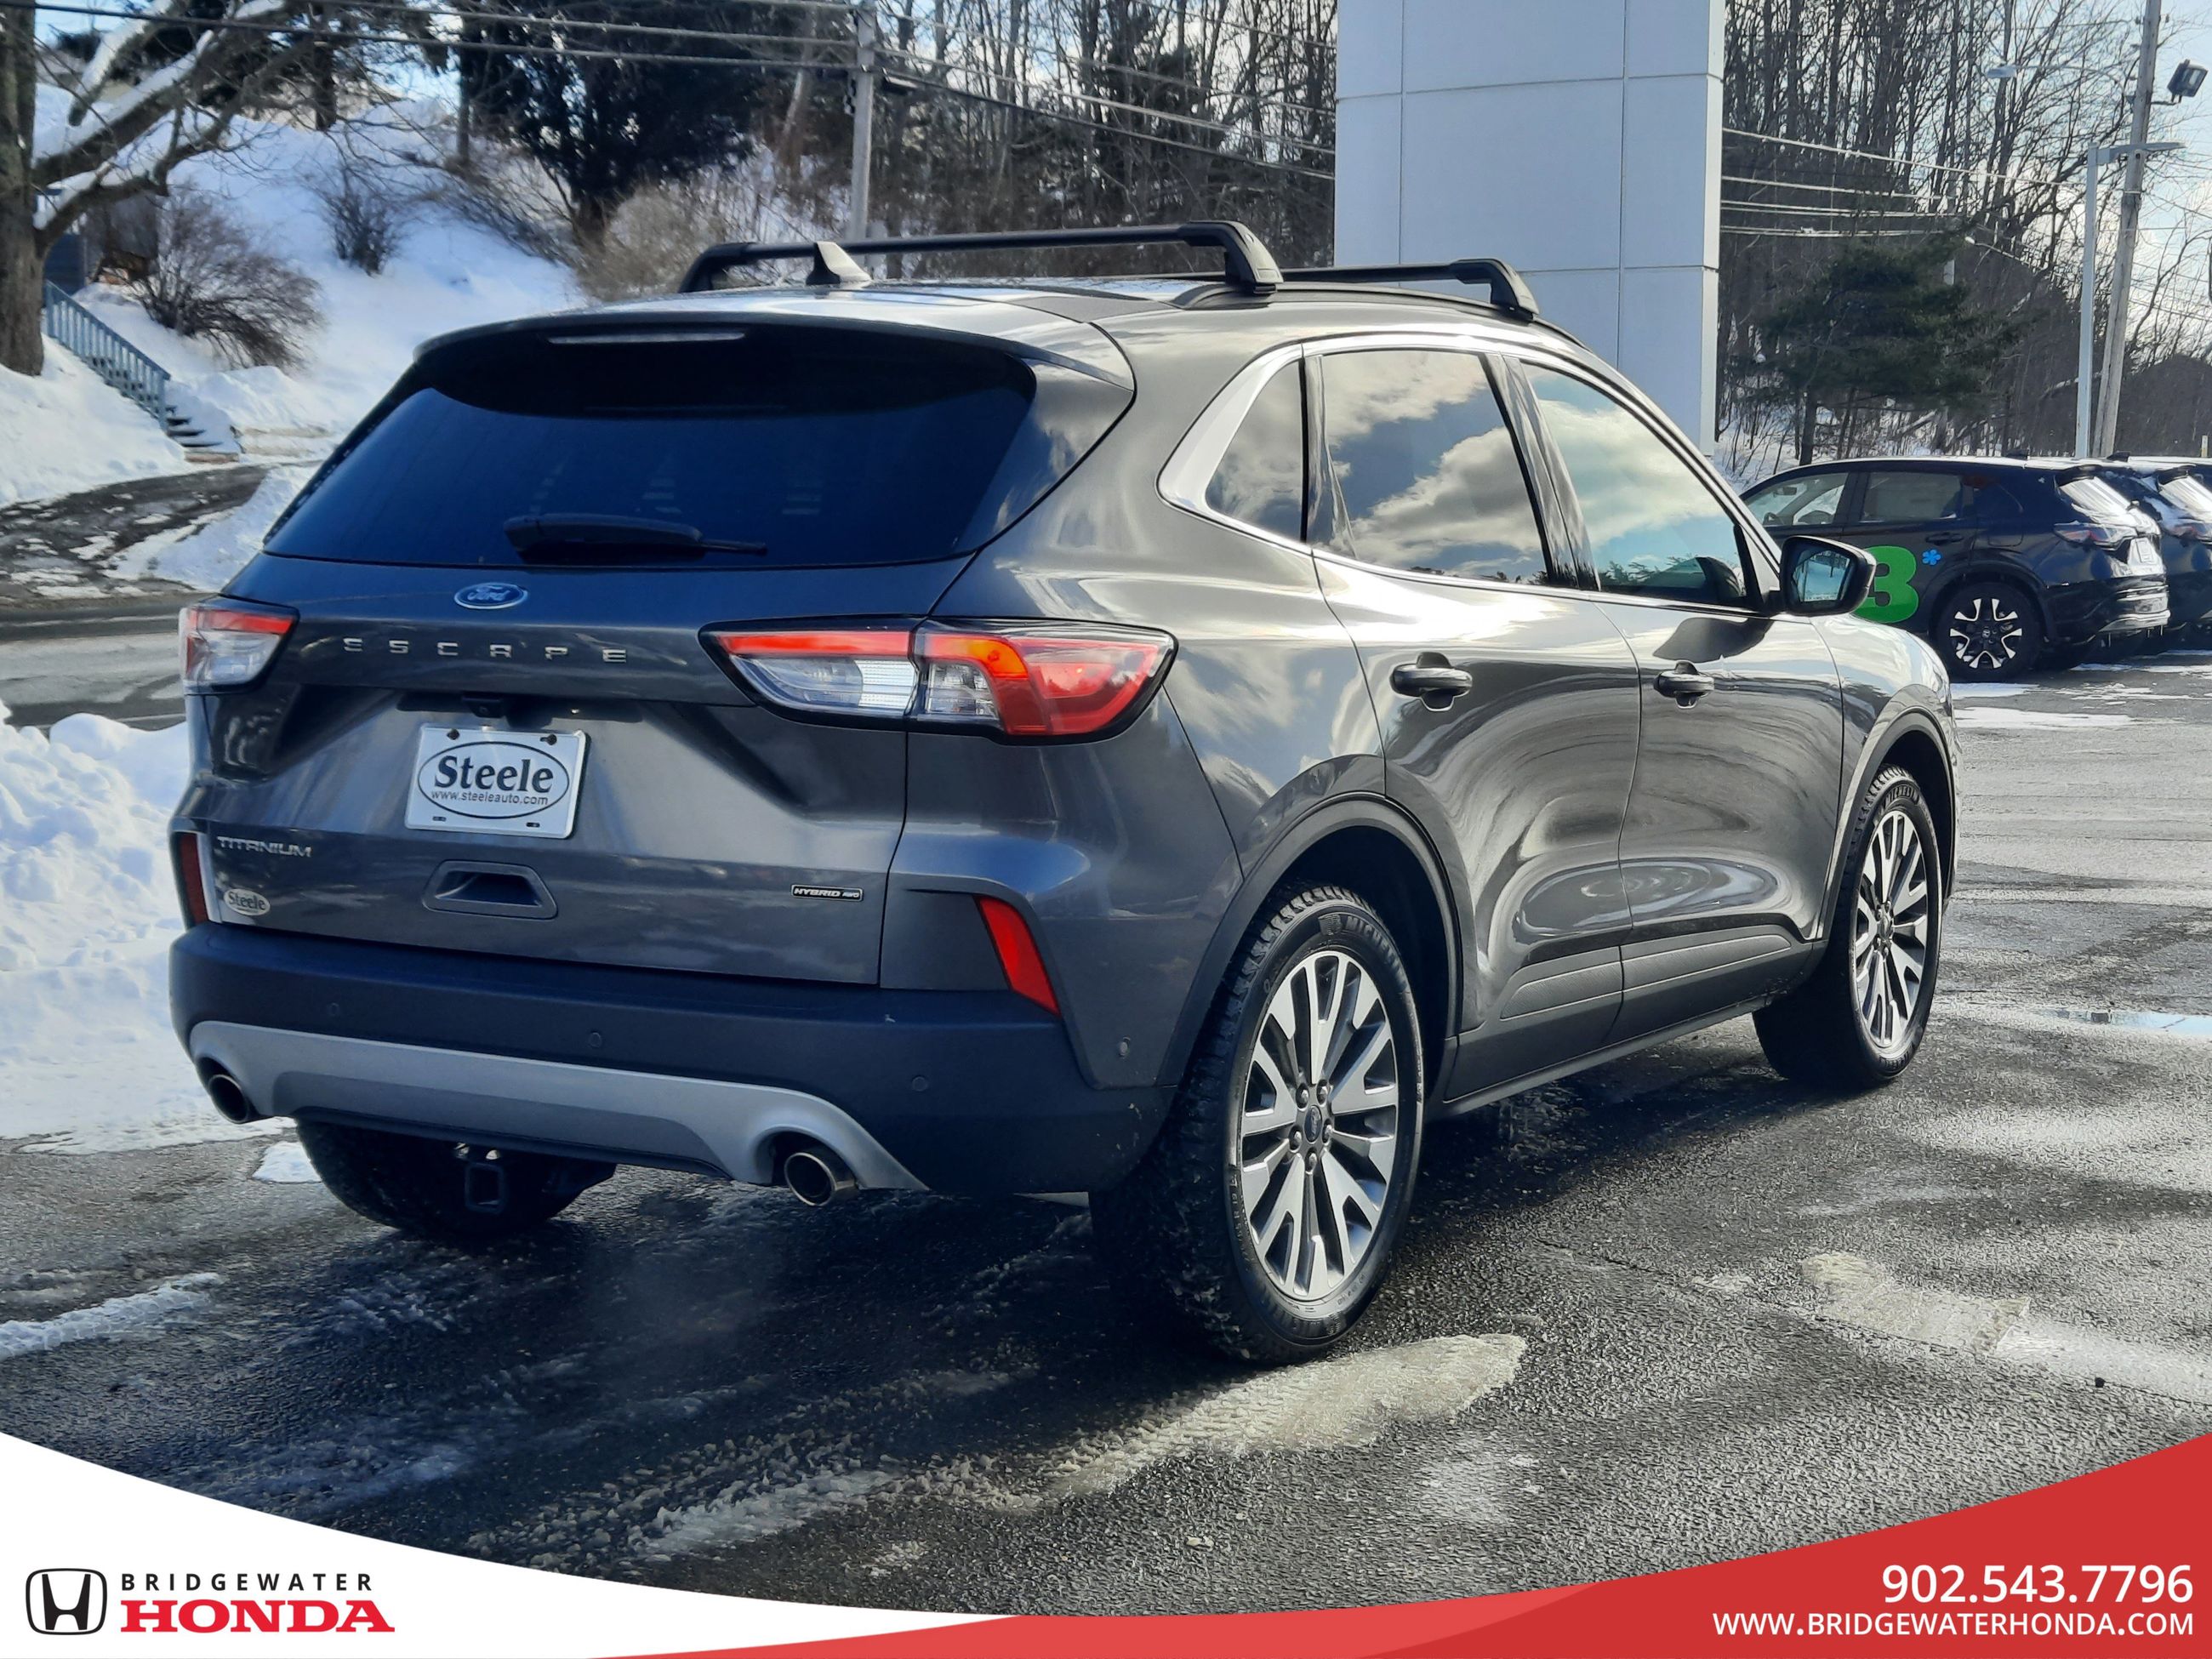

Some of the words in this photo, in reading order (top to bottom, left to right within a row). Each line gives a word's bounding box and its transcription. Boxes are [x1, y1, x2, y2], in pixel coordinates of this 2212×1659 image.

[467, 583, 511, 601] Ford
[343, 638, 627, 663] ESCAPE
[434, 755, 554, 793] Steele
[430, 790, 549, 806] www.steeleauto.com
[217, 836, 311, 858] TITANIUM
[228, 891, 267, 911] Steele
[794, 887, 841, 898] HYBRID
